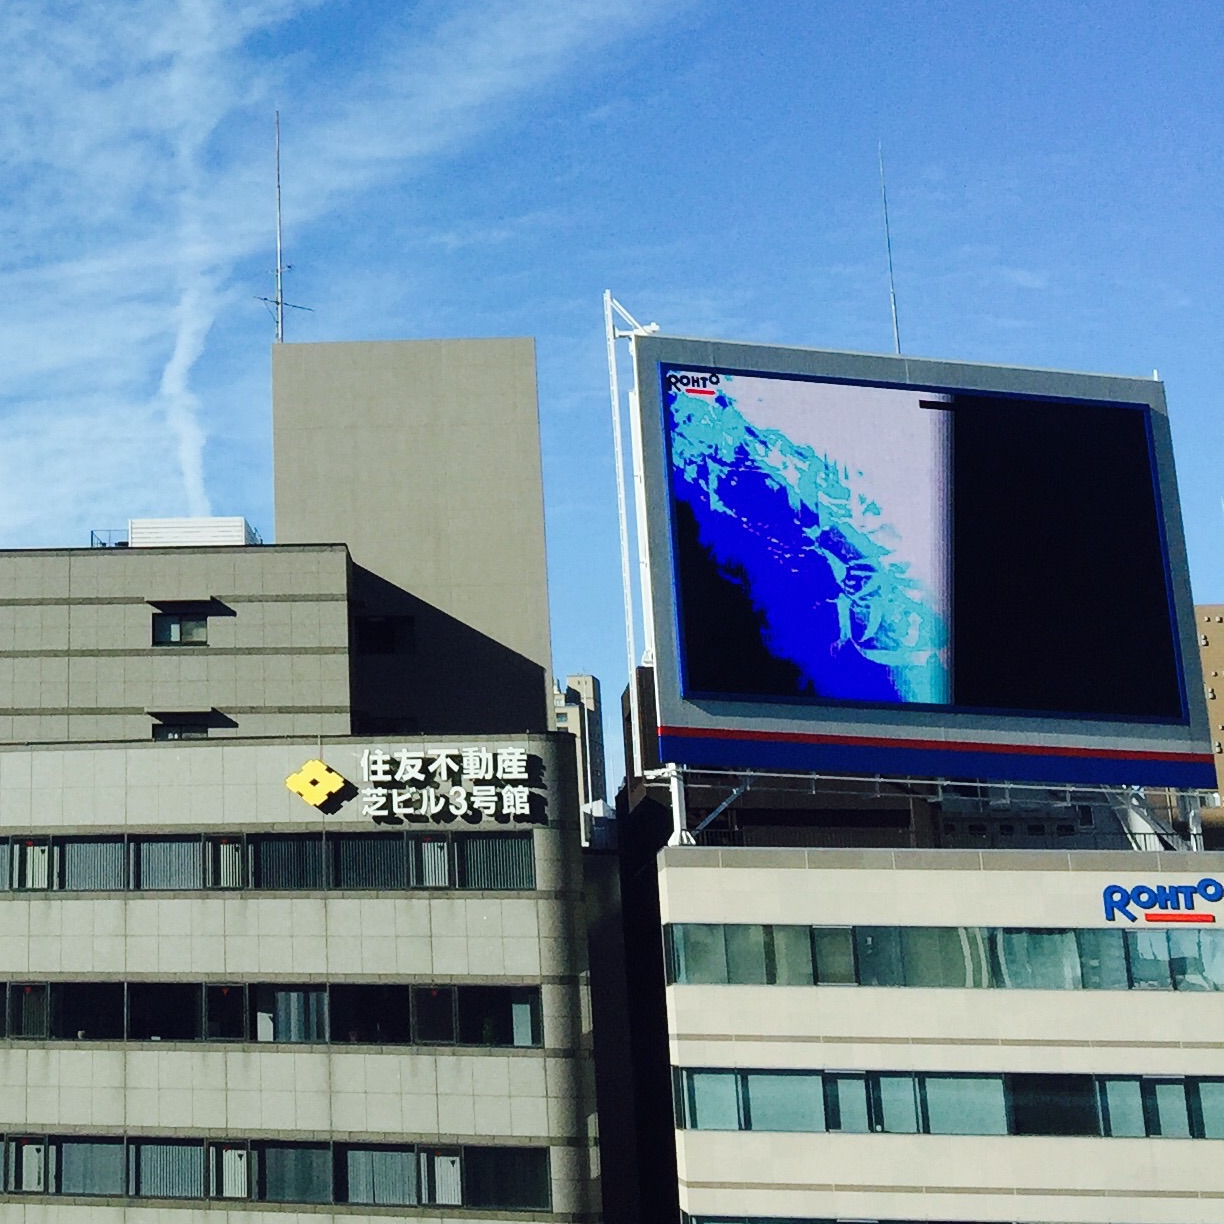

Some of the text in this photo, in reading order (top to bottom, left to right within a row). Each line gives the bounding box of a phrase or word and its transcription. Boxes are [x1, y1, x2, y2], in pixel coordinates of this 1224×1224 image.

[667, 374, 720, 392] ROHTO
[360, 747, 529, 782] 住友不動産
[361, 785, 531, 816] 芝ビル3号館
[1103, 878, 1224, 923] ROHTO
